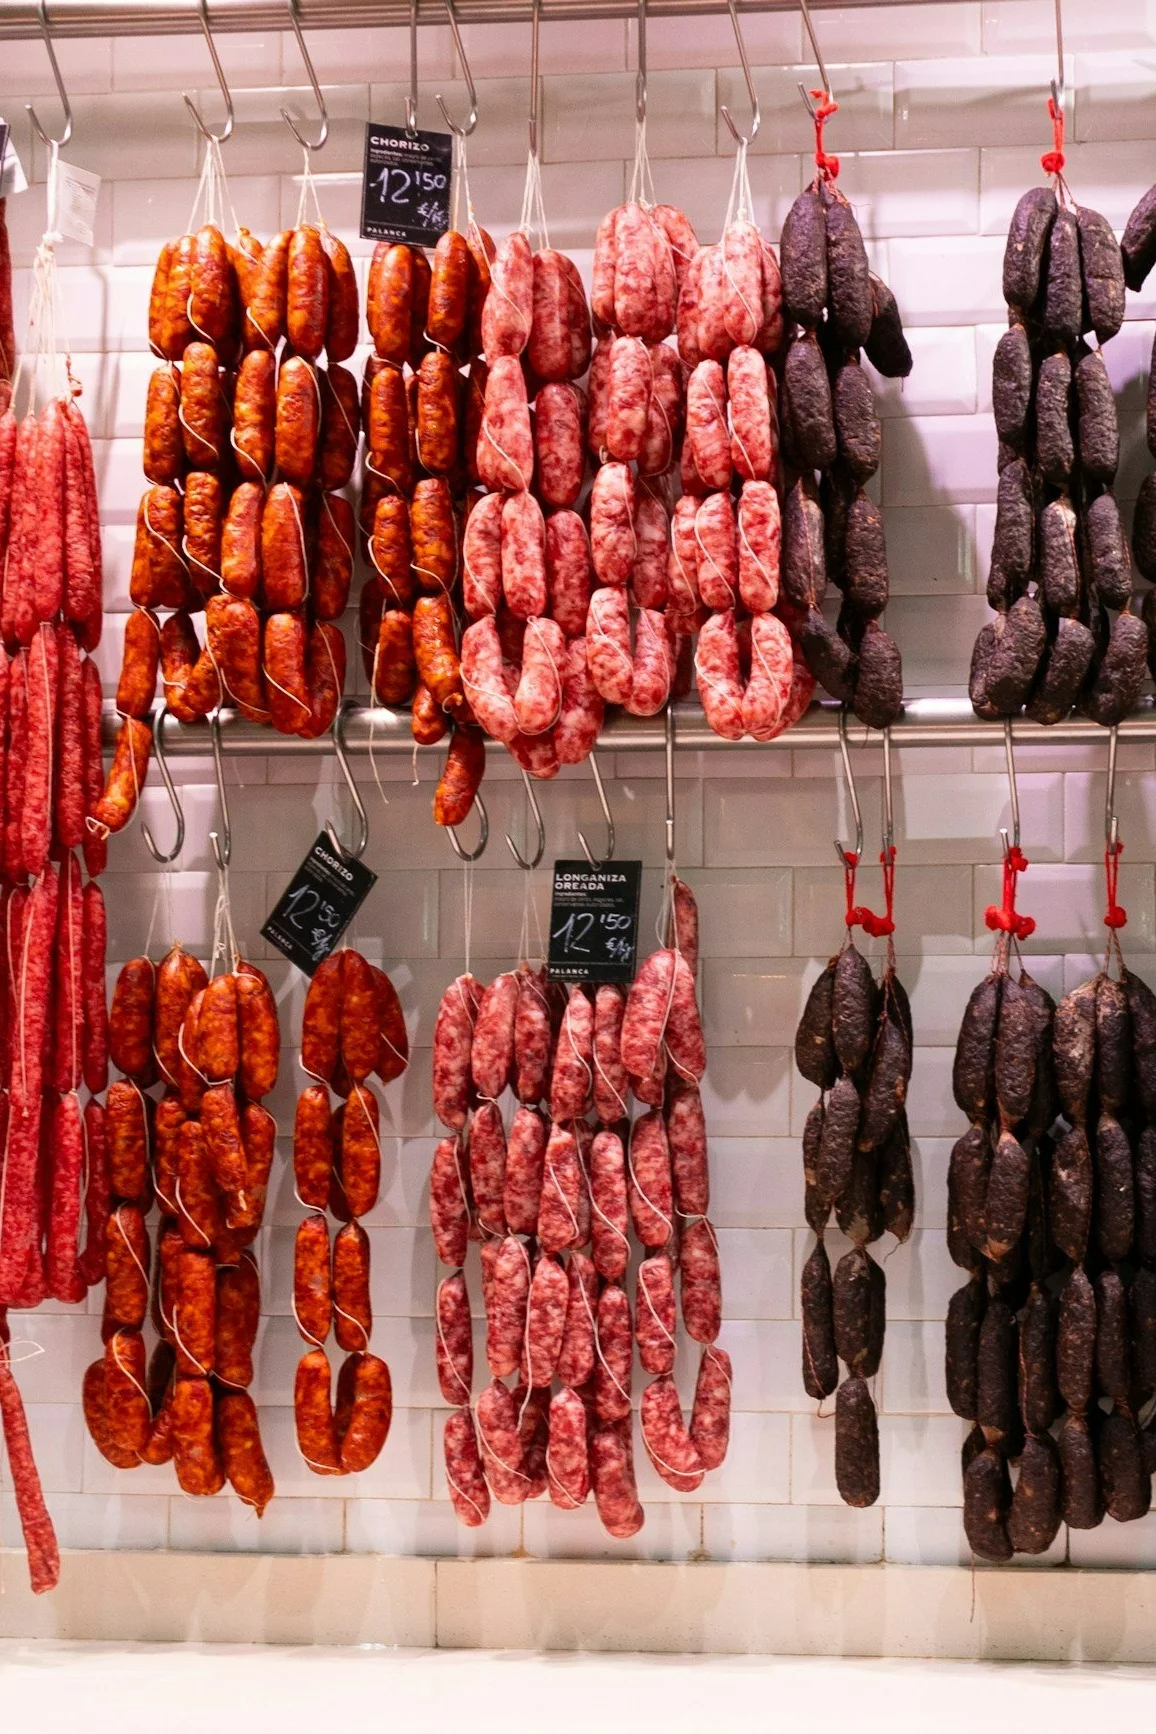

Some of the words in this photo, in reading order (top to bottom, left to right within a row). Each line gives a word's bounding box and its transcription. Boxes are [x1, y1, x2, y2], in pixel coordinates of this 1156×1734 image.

[370, 136, 430, 152] CHORIZO
[367, 227, 407, 237] PALANCA
[315, 846, 354, 881] CHORIZO
[555, 873, 627, 882] LONGANIZA
[554, 882, 605, 890] OREADA
[267, 926, 293, 950] PALANCA
